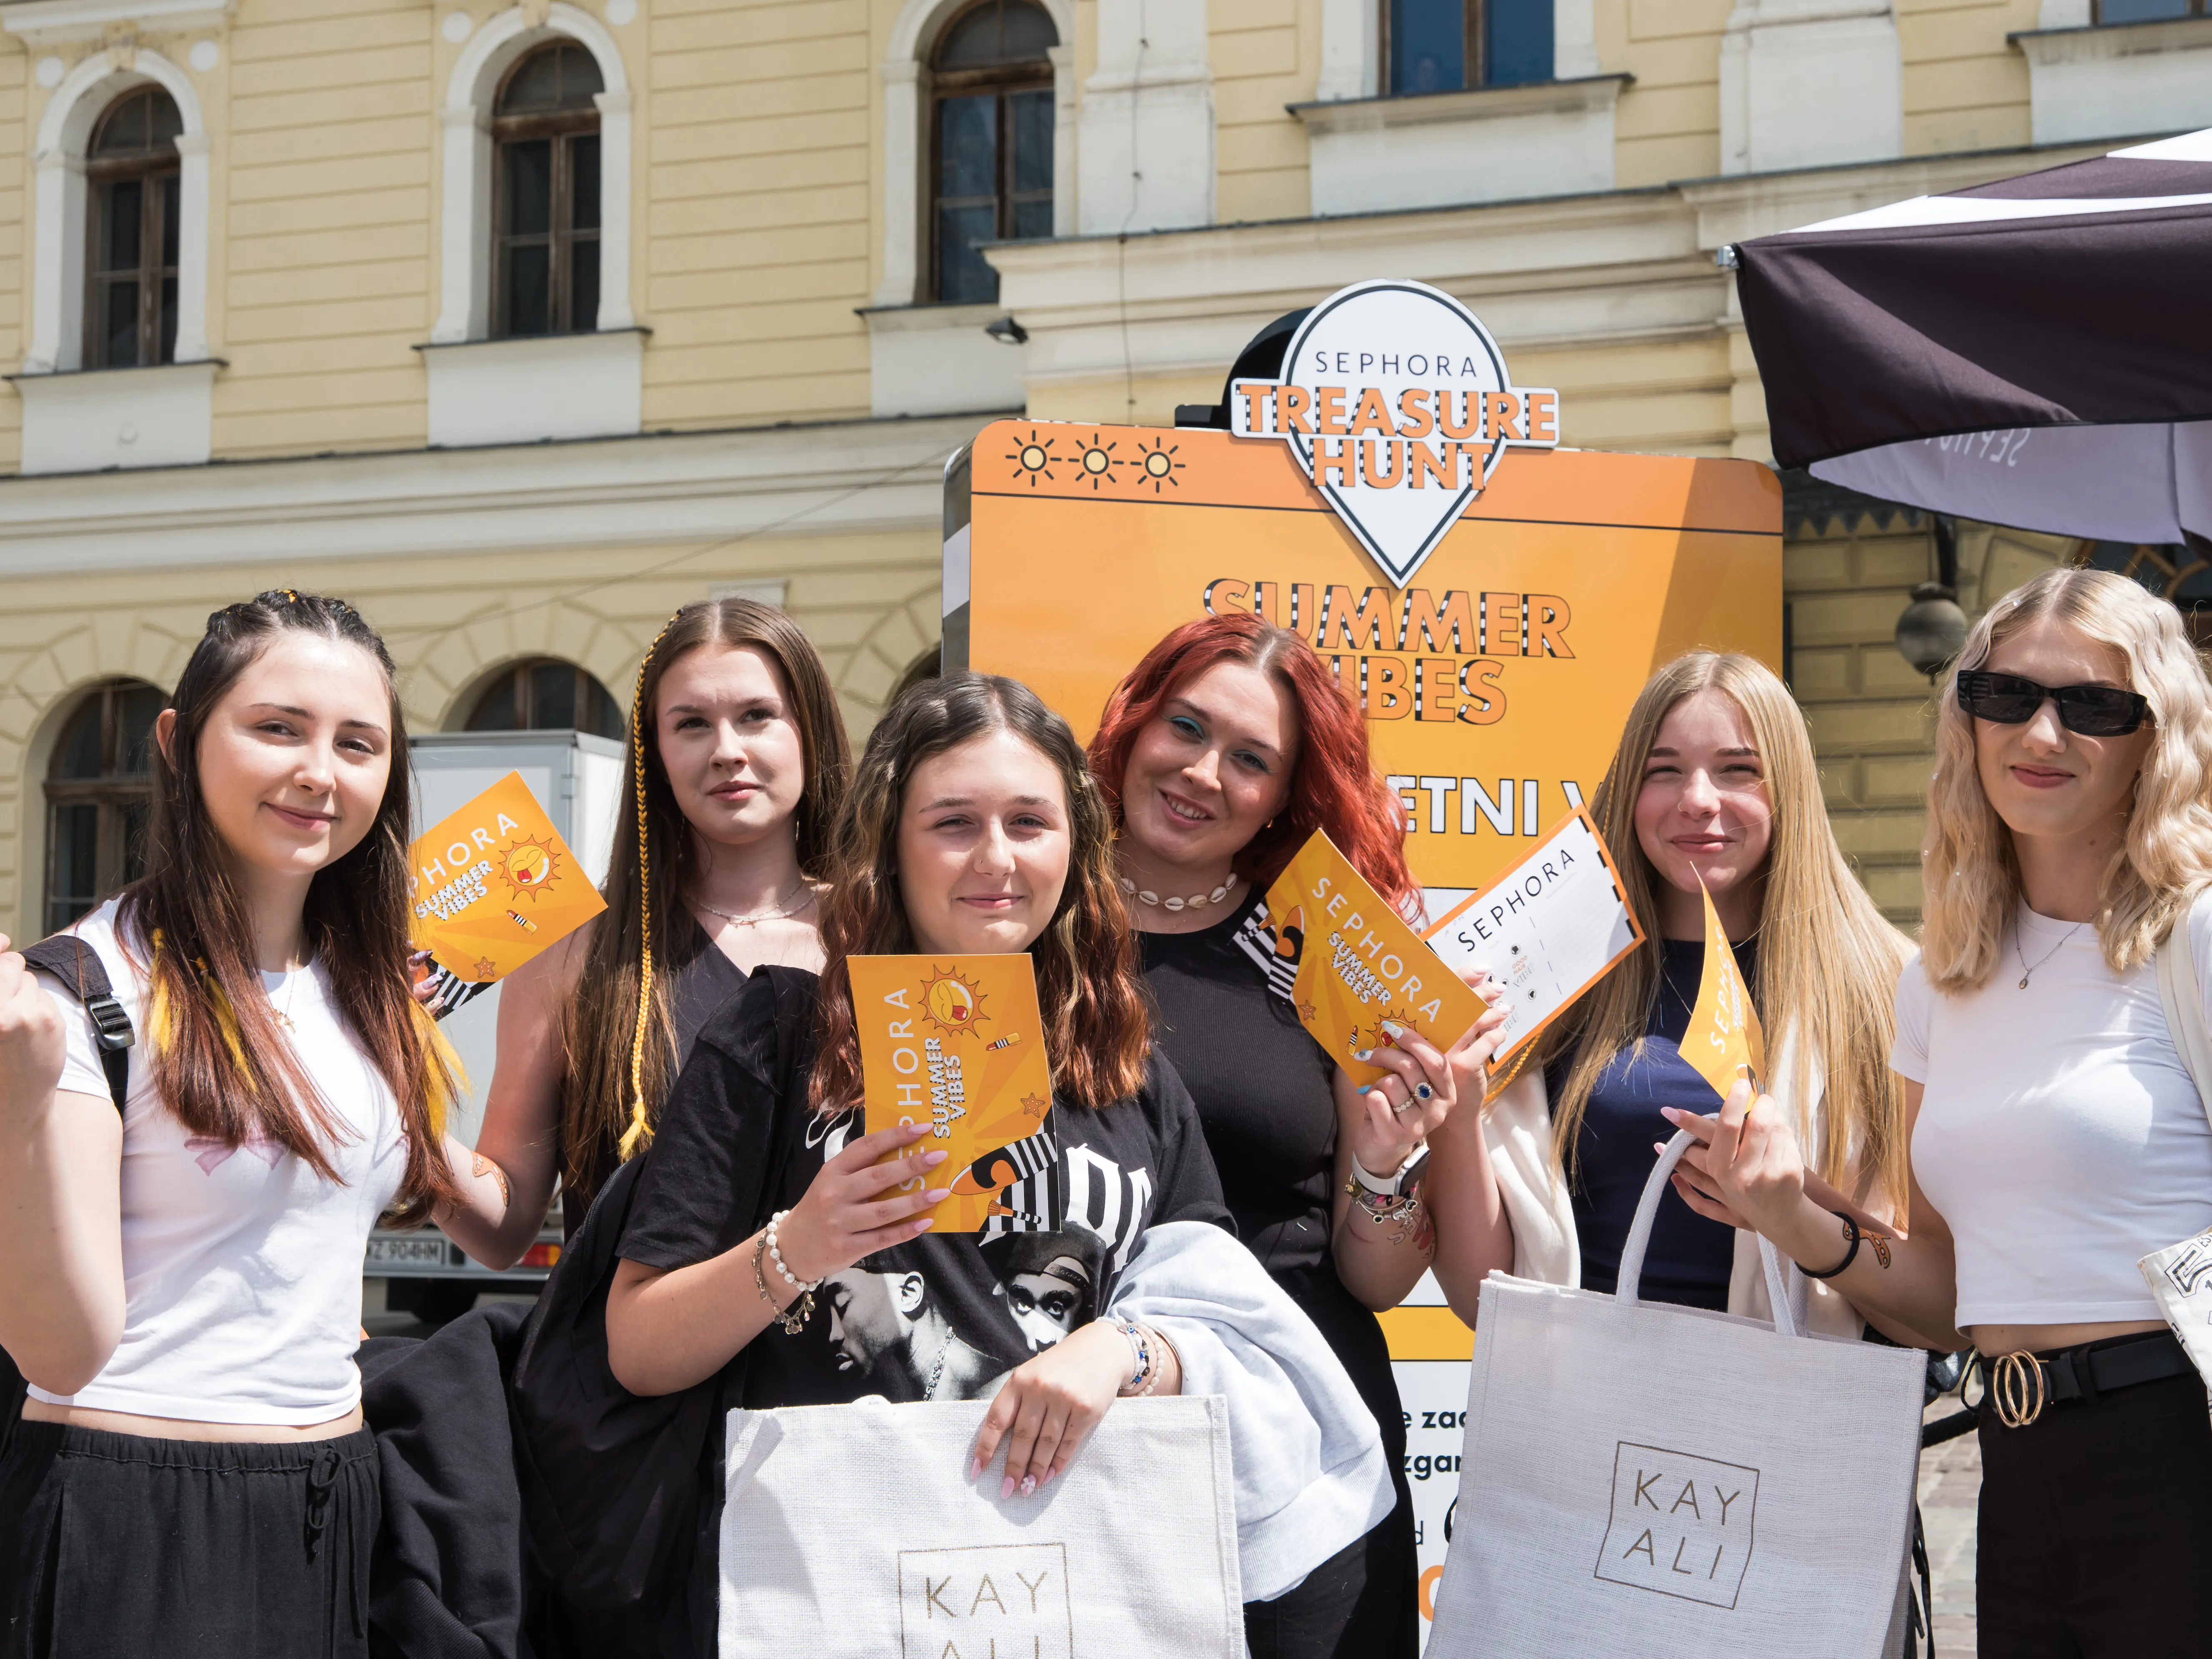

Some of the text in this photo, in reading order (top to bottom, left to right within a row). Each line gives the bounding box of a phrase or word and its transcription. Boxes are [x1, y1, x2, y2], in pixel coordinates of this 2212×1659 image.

[1316, 351, 1477, 377] SEPHORA
[1235, 384, 1556, 441] TREASURE
[1309, 438, 1493, 490] HUNT
[1203, 578, 1576, 659] SUMMER
[414, 859, 494, 919] SUMMER
[433, 881, 488, 921] VIBES
[1458, 849, 1575, 952] SEPHORA
[1312, 877, 1442, 1023] SEPHORA
[1327, 931, 1392, 1007] SUMMER
[1332, 951, 1372, 1004] VIBES
[924, 1036, 951, 1139] SUMMER
[943, 1055, 966, 1121] VIBES
[1635, 1469, 1741, 1526] KAY
[1623, 1528, 1723, 1579] ALI
[925, 1571, 1048, 1619] KAY
